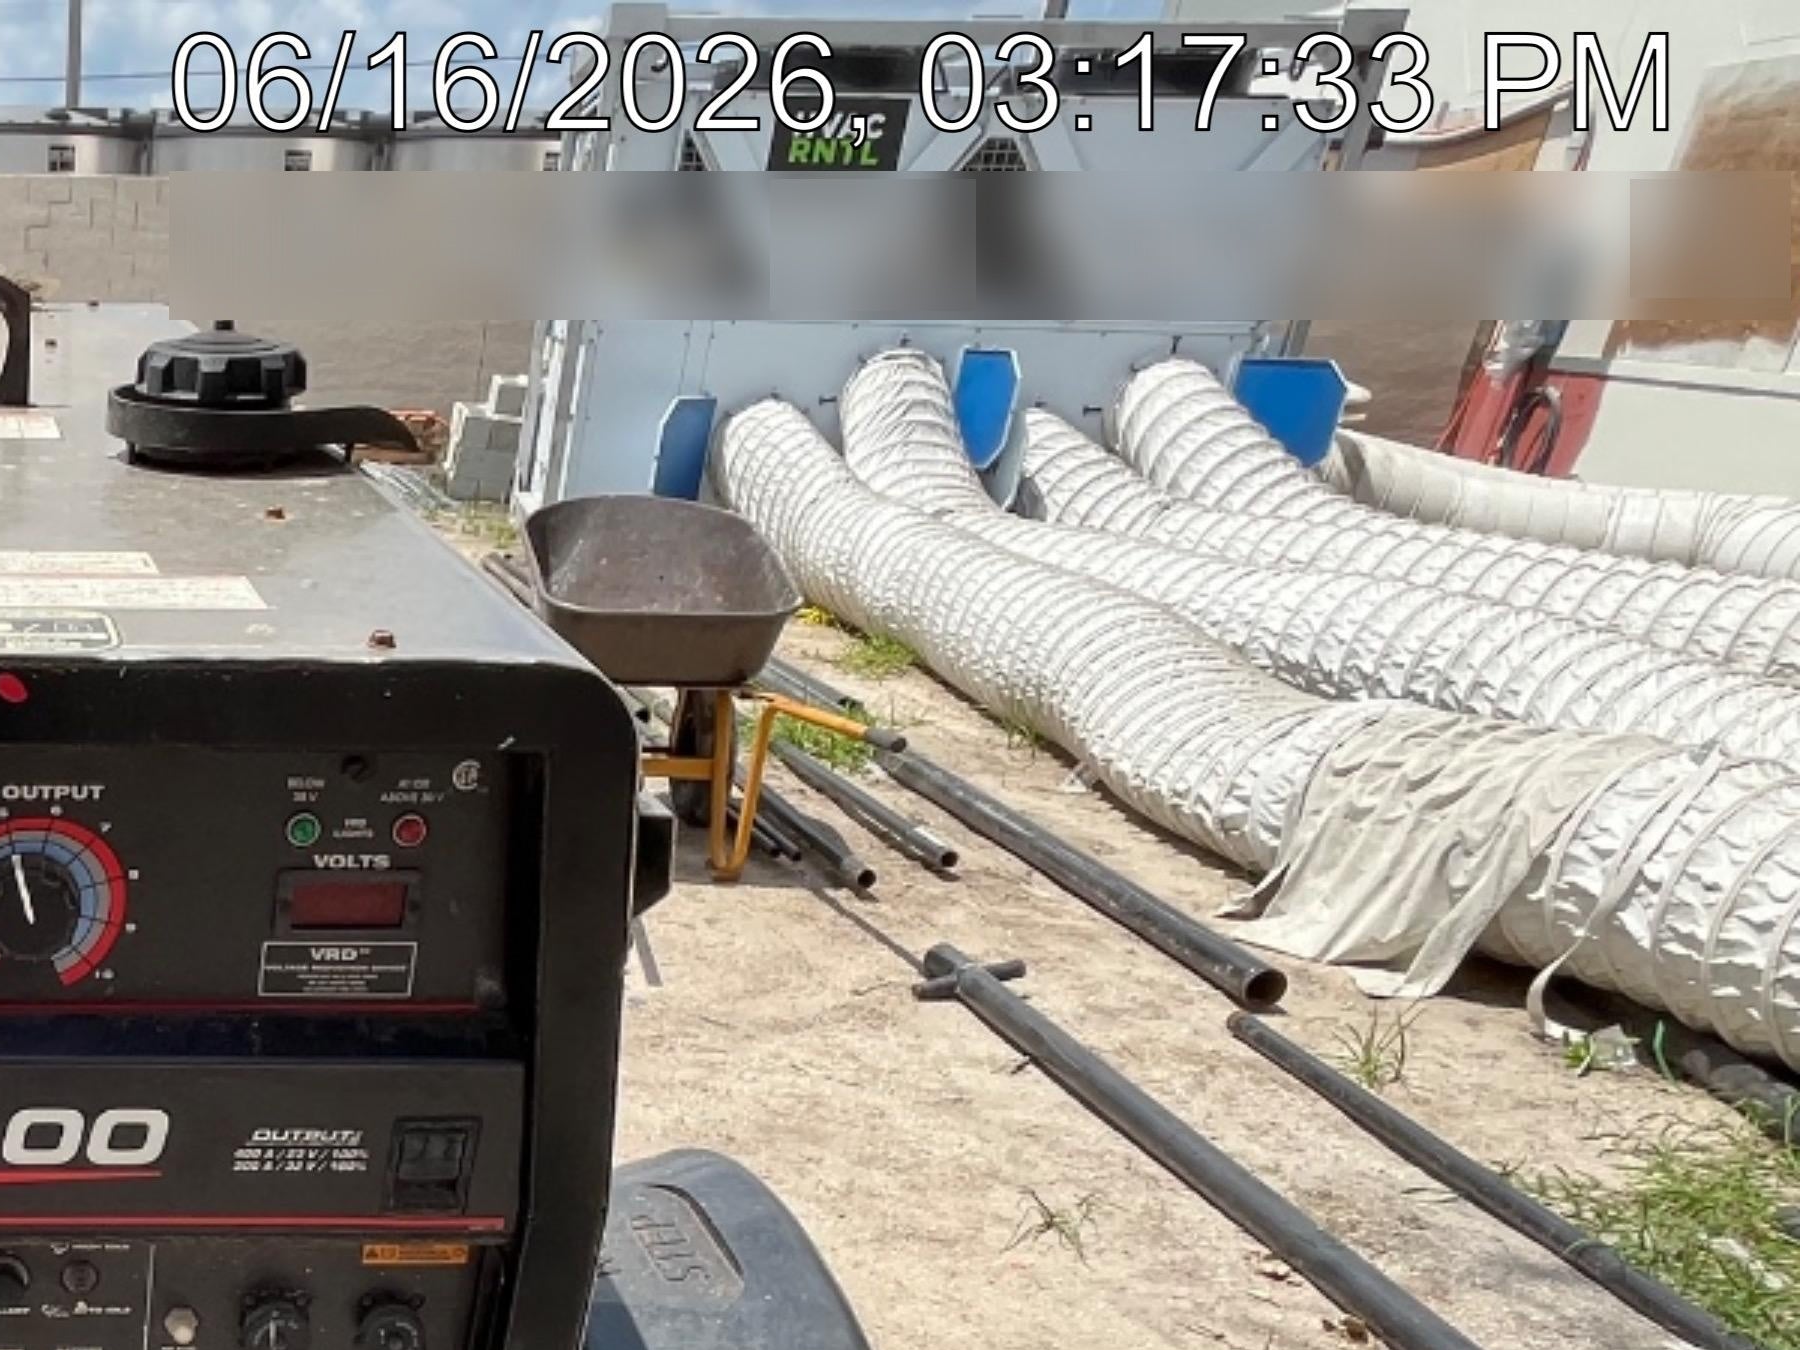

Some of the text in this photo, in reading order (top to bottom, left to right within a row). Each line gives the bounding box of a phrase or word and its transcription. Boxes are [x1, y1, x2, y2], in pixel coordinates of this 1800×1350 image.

[788, 137, 878, 165] RNTL
[2, 785, 105, 800] OUTPUT
[313, 854, 391, 869] VOLTS
